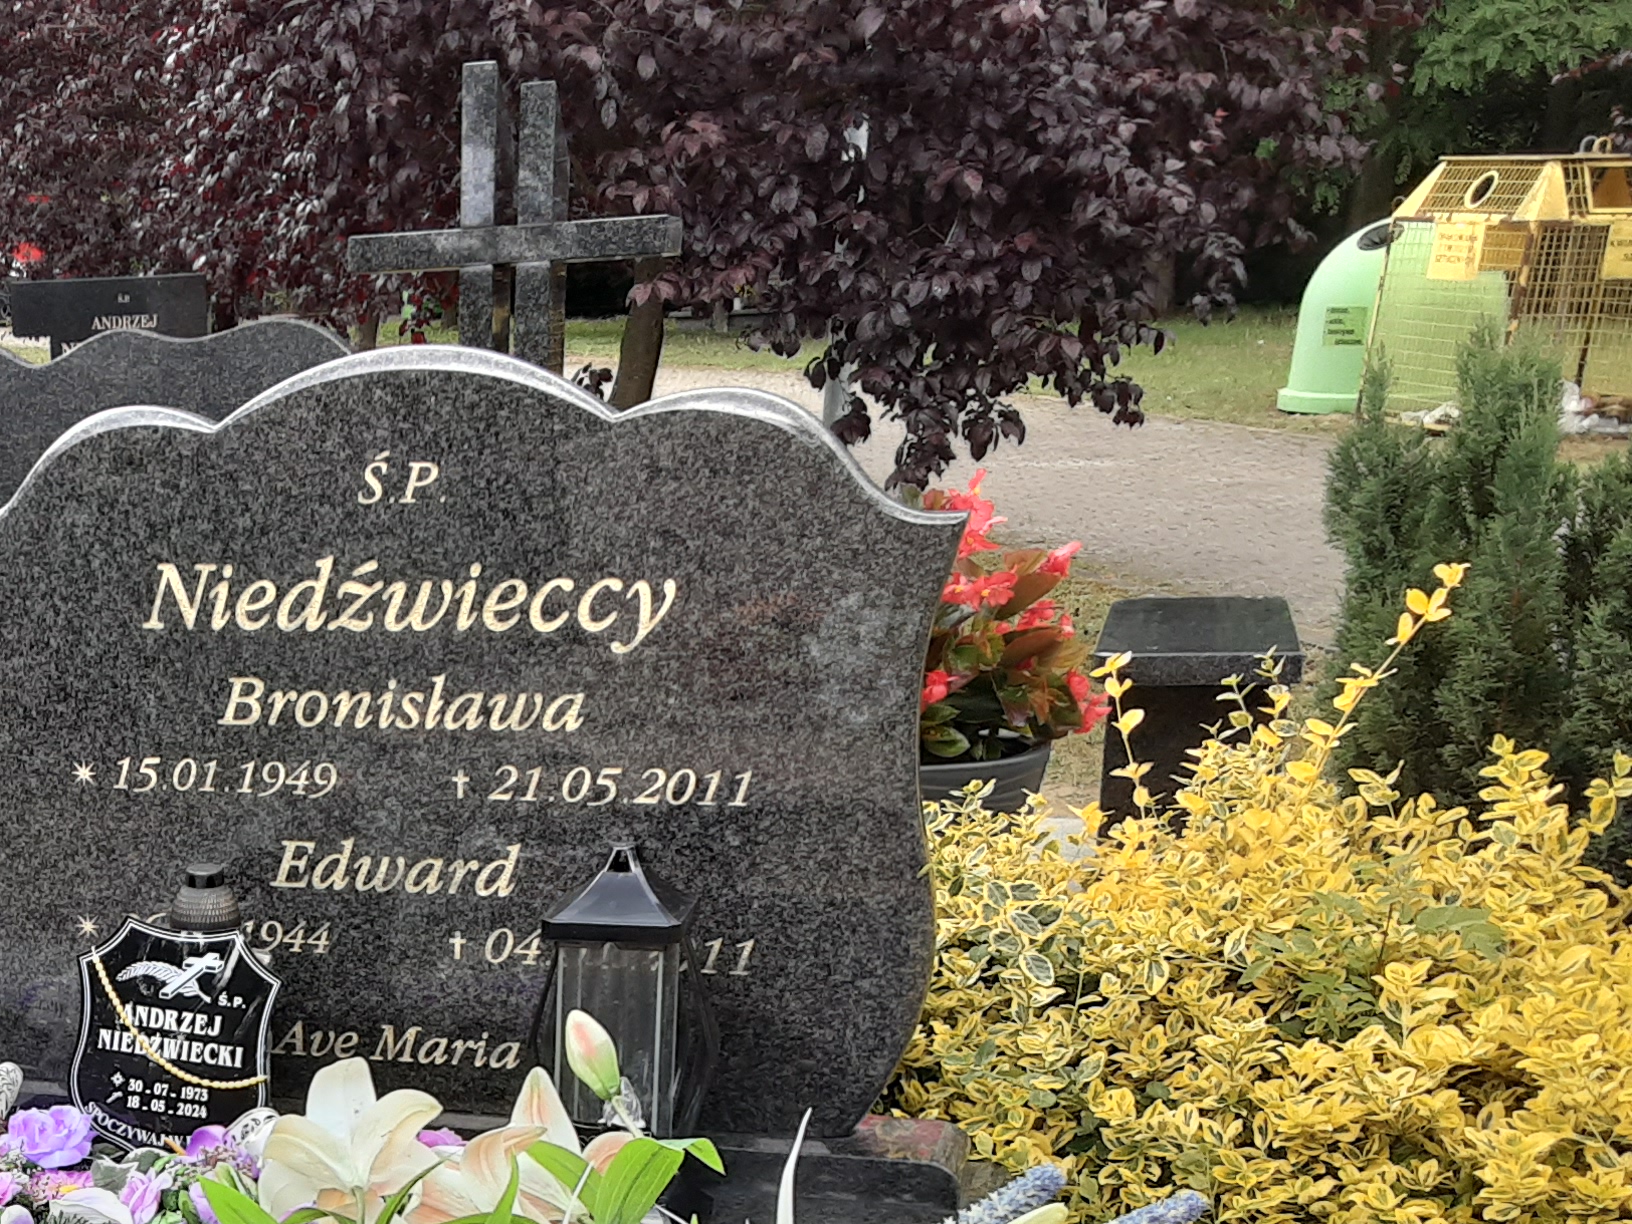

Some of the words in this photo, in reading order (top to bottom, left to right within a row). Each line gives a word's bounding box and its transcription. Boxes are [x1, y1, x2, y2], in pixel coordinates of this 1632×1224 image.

[91, 314, 159, 330] ANDRZEJ
[358, 451, 447, 504] Ś.P.
[142, 555, 677, 654] Niedźwieccy
[217, 675, 586, 733] Bronisława
[112, 756, 338, 799] 15.01.1949
[487, 764, 754, 808] 21.05.2011
[269, 837, 522, 898] Edward
[116, 1001, 222, 1038] ANDRZEJ
[217, 991, 247, 1010] Ś.P.
[97, 1028, 244, 1070] NIEDŹWIECKI
[270, 1020, 359, 1058] Ave
[369, 1024, 521, 1070] Maria
[126, 1094, 141, 1111] 18
[150, 1098, 166, 1113] 05
[176, 1102, 208, 1120] 2024
[127, 1078, 143, 1094] 30
[153, 1081, 169, 1097] 07
[180, 1086, 209, 1103] 1973
[84, 1100, 168, 1148] SPOCZYWAJ
